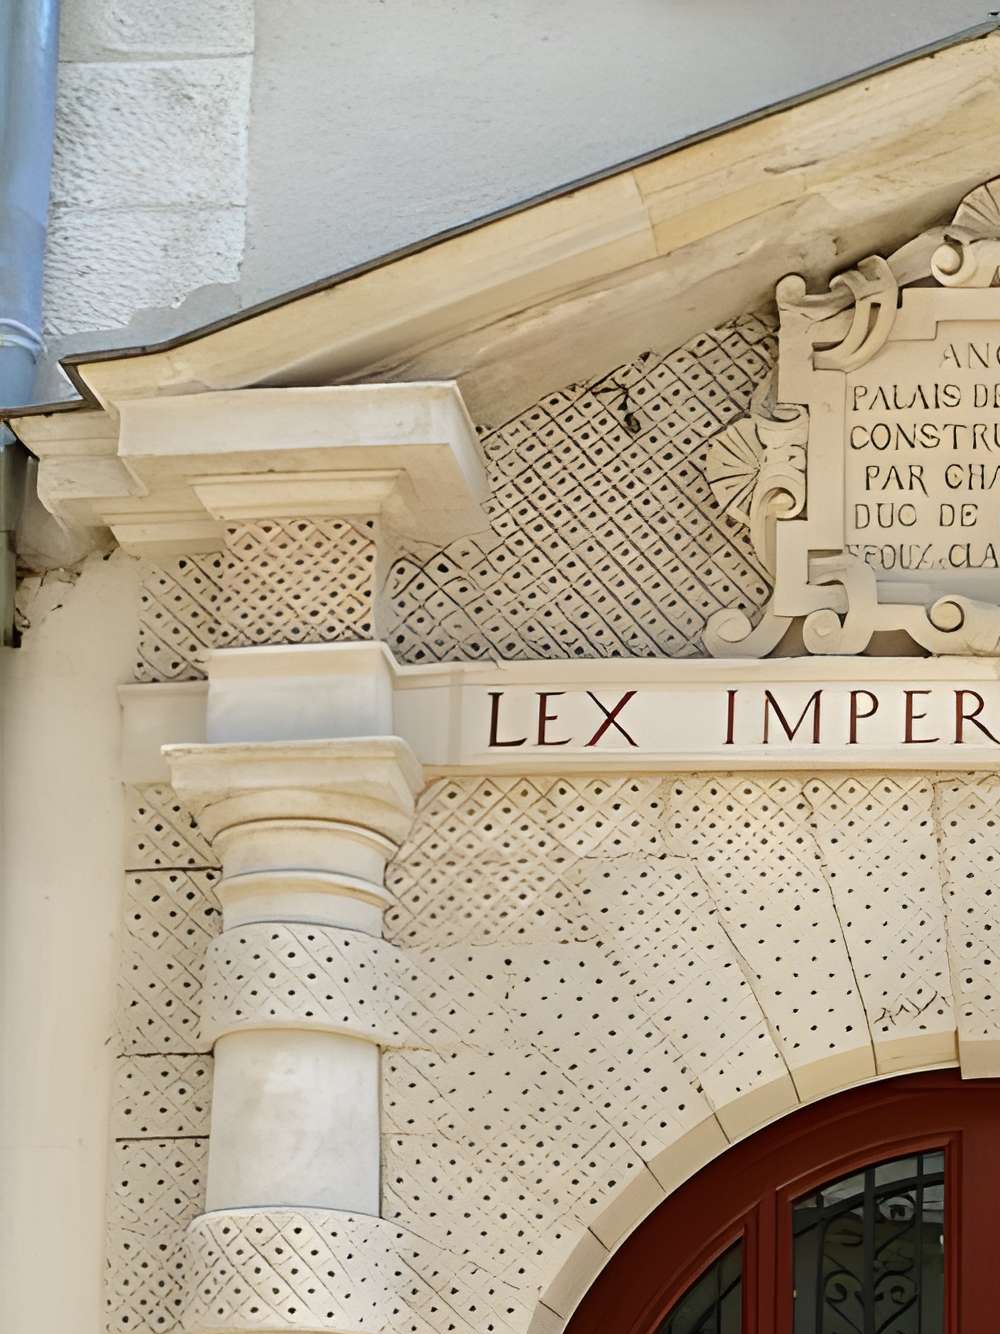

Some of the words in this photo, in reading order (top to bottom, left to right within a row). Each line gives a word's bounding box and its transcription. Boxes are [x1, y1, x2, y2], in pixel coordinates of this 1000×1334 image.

[852, 383, 961, 411] PALAIS
[864, 464, 929, 497] PAR
[854, 502, 918, 530] DUC
[939, 503, 979, 527] DE
[489, 690, 639, 748] LEX
